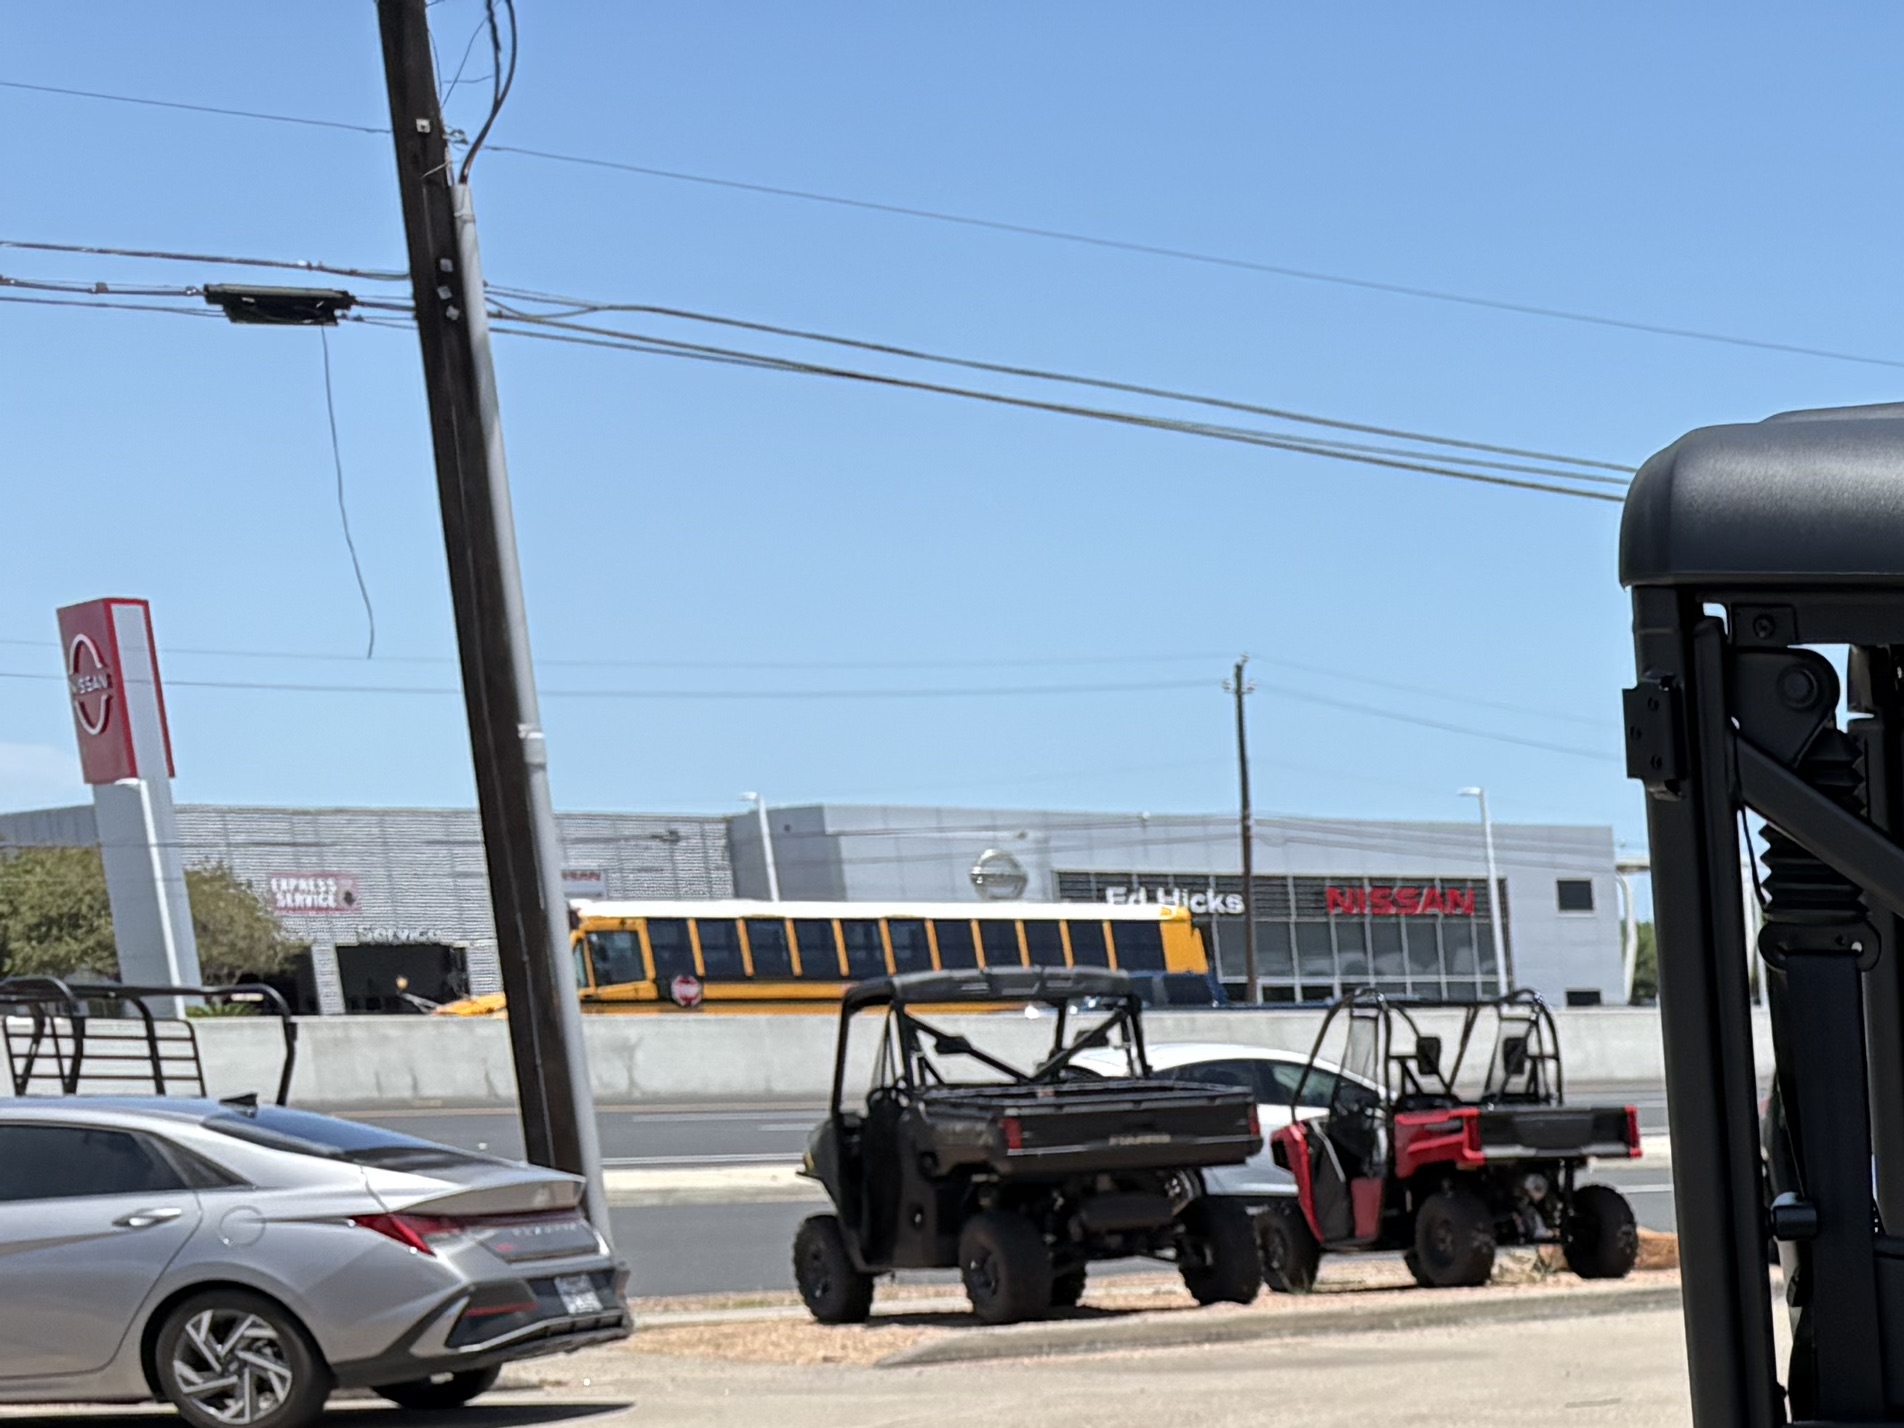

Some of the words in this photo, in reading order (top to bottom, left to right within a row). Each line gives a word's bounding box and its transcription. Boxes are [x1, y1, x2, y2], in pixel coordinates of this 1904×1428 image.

[1105, 886, 1147, 905] Ed
[1156, 886, 1245, 914] Hicks
[1324, 886, 1475, 915] NISSAN
